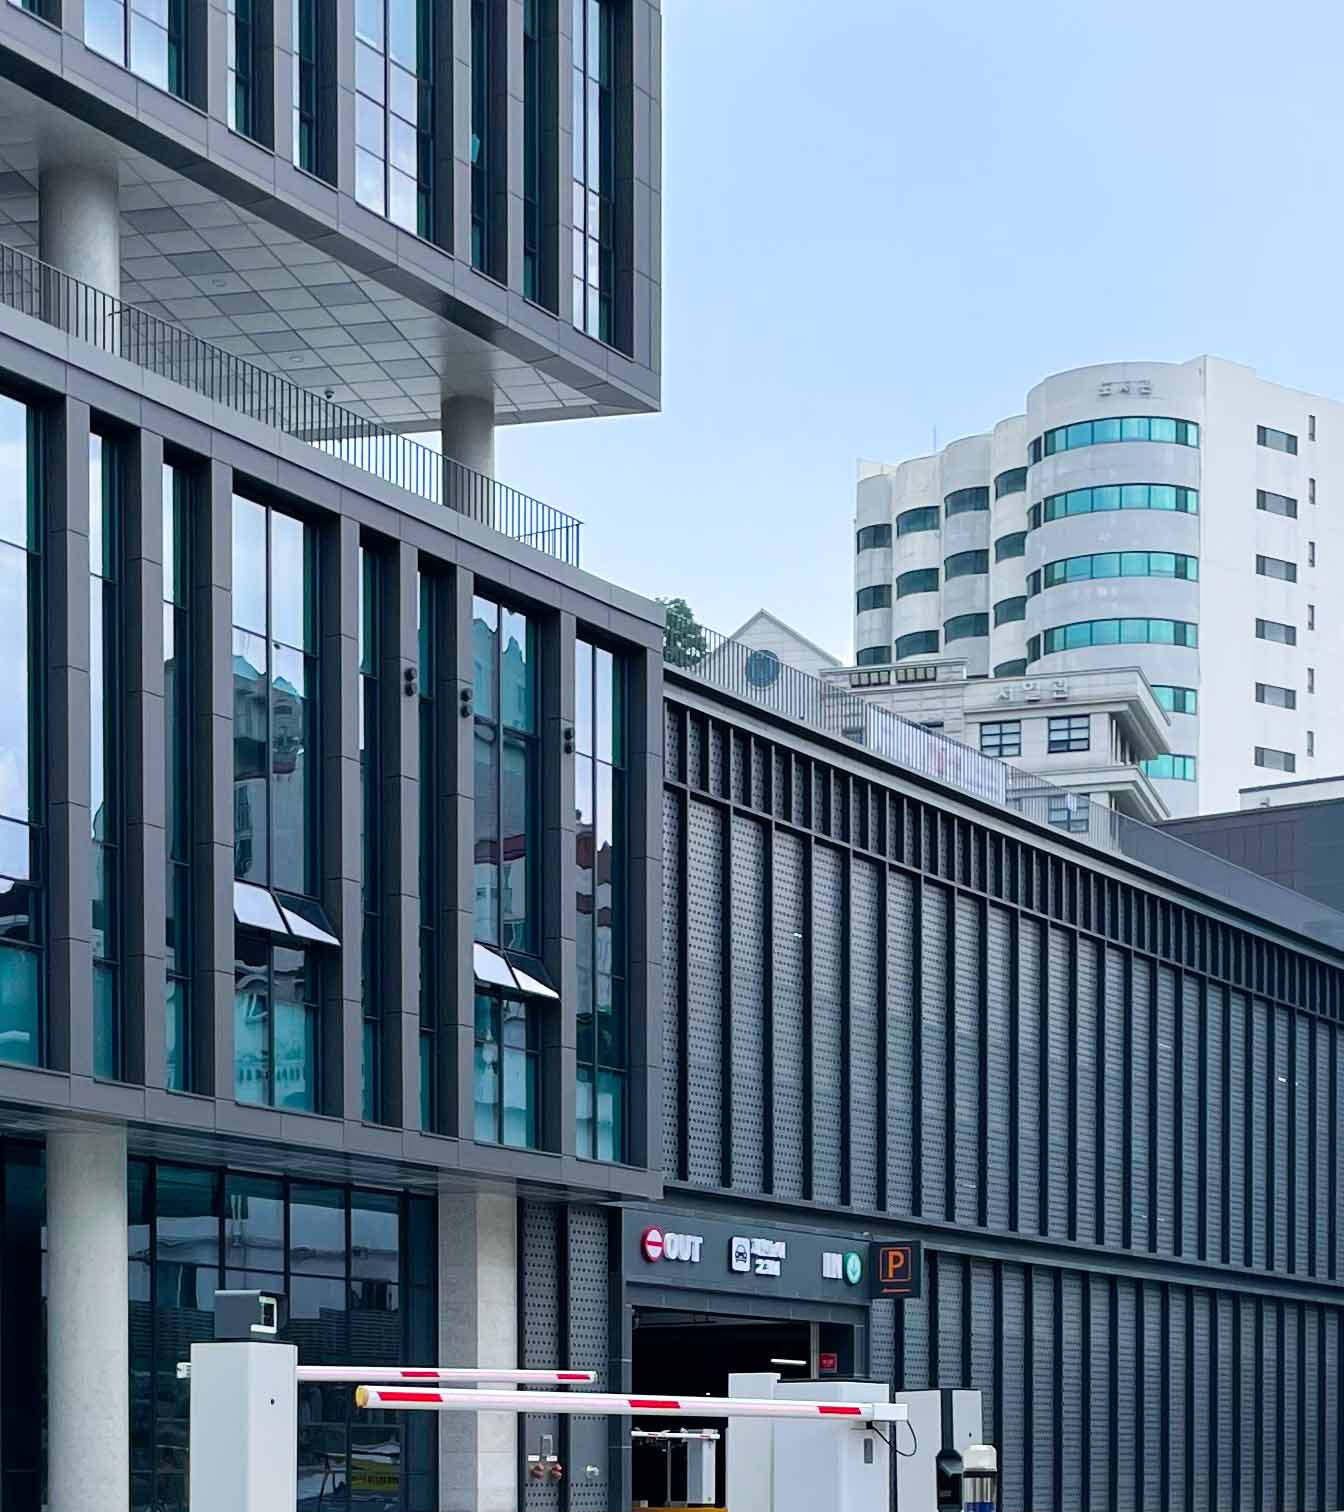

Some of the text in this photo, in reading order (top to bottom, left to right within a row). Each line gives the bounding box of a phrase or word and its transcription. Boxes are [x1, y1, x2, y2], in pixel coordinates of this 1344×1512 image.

[665, 1233, 704, 1263] OUT
[822, 1251, 843, 1279] IN
[887, 1250, 905, 1279] P
